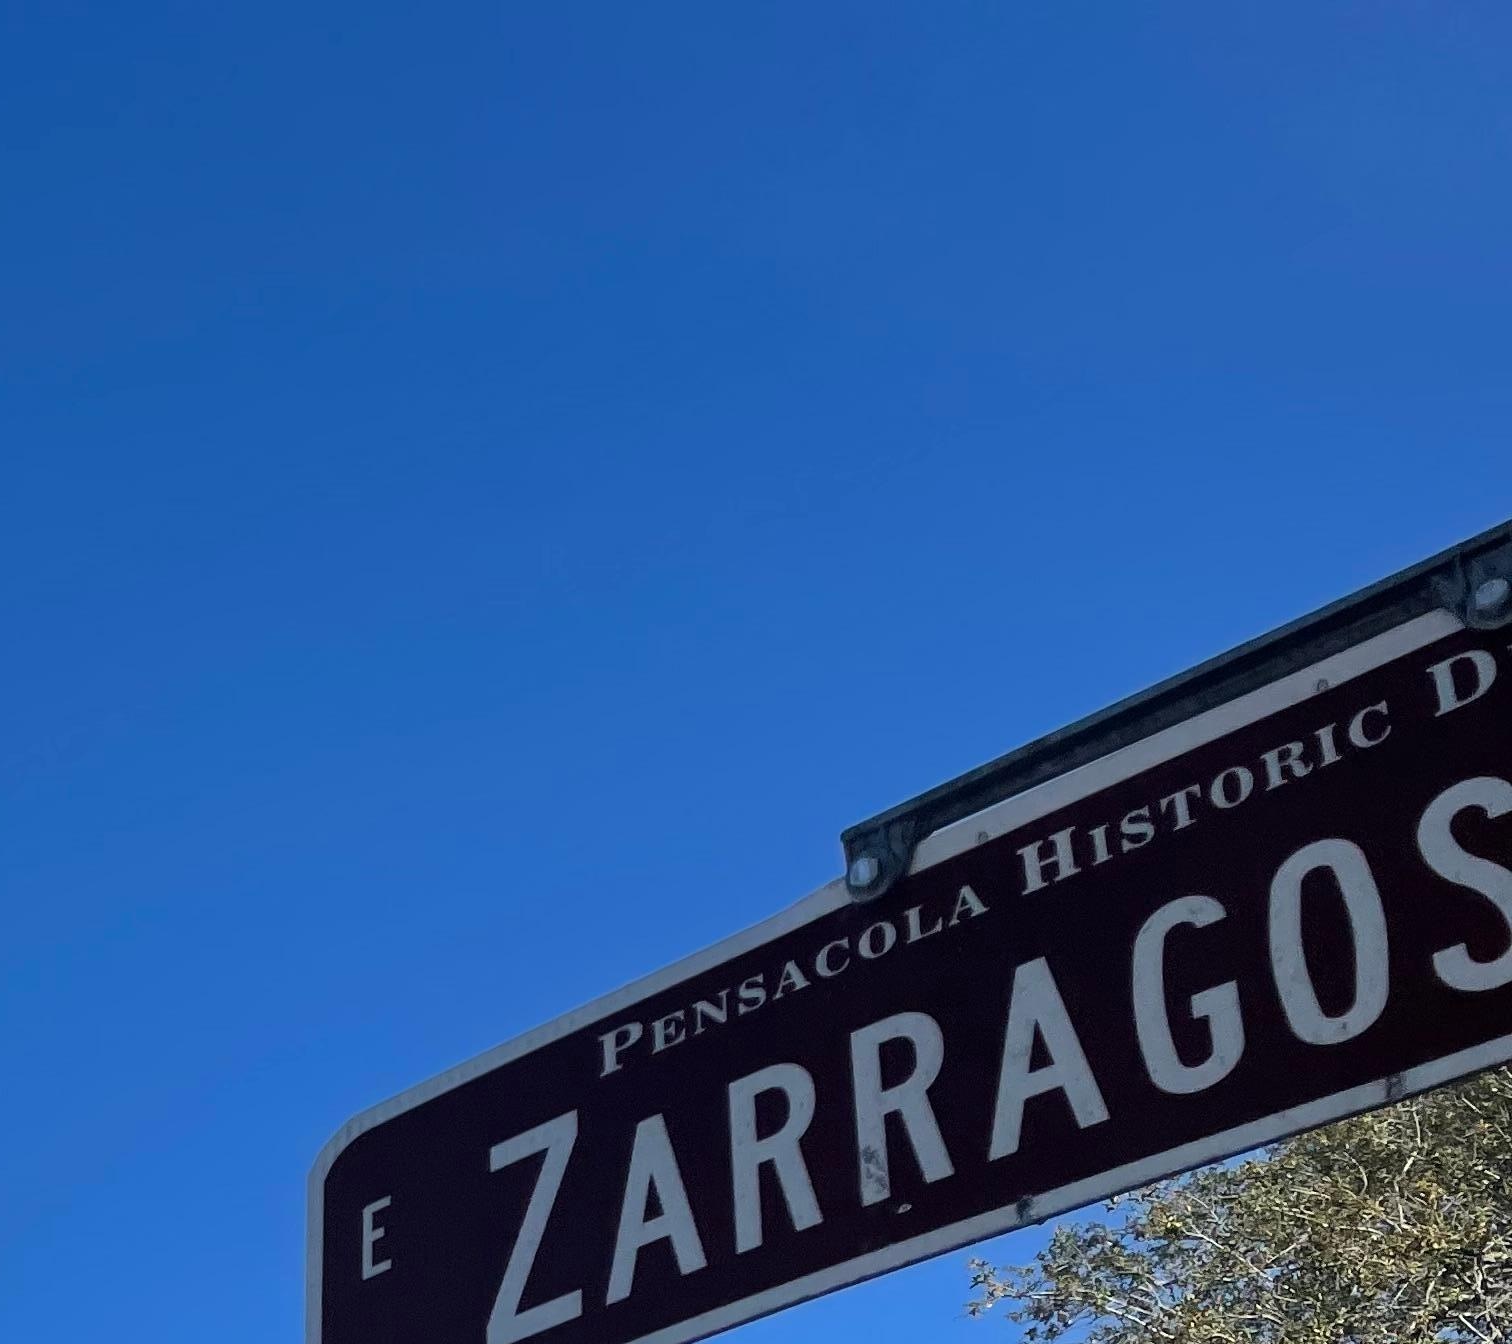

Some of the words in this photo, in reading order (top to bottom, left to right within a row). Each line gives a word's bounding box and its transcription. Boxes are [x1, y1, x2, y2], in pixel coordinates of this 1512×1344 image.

[599, 884, 990, 1079] PENSACOLA
[1019, 700, 1392, 895] HISTORIC
[1426, 645, 1512, 718] D
[361, 1195, 392, 1281] E
